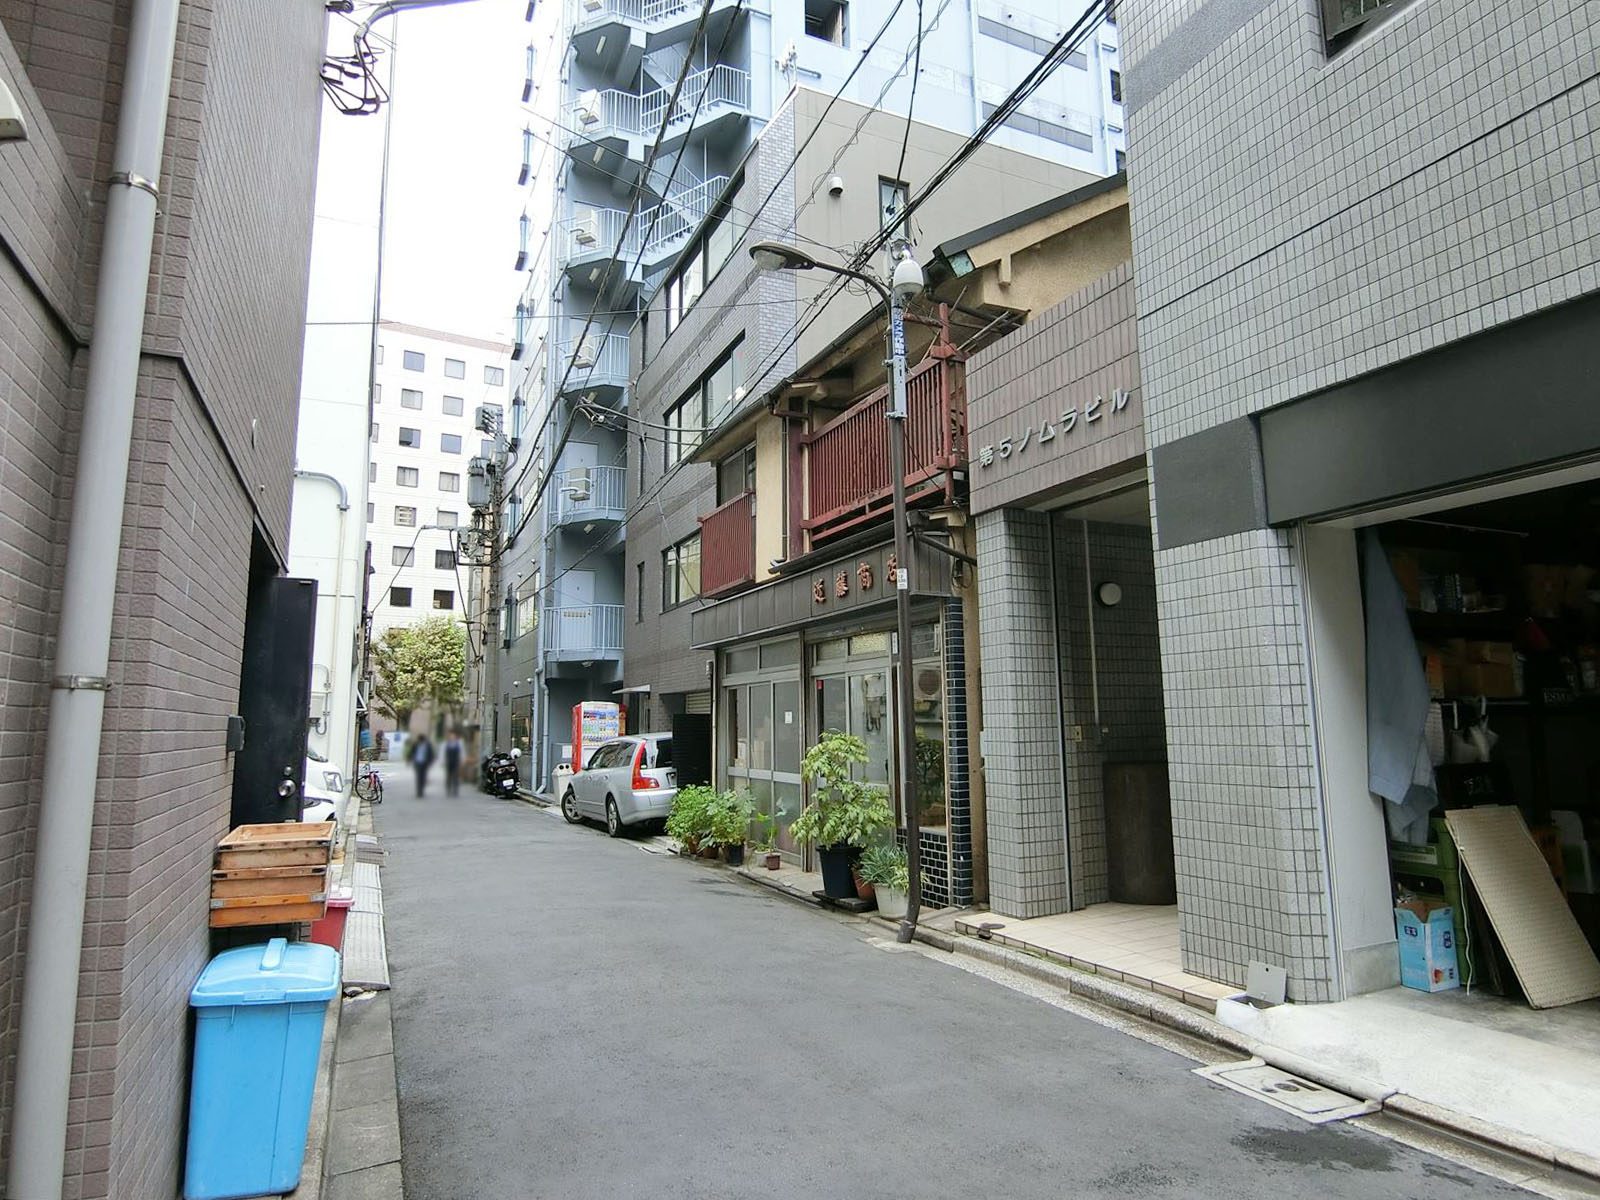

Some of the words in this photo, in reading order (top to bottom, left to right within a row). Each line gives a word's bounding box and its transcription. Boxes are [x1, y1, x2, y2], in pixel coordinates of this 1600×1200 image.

[979, 387, 1130, 468] 第5ノムラビル
